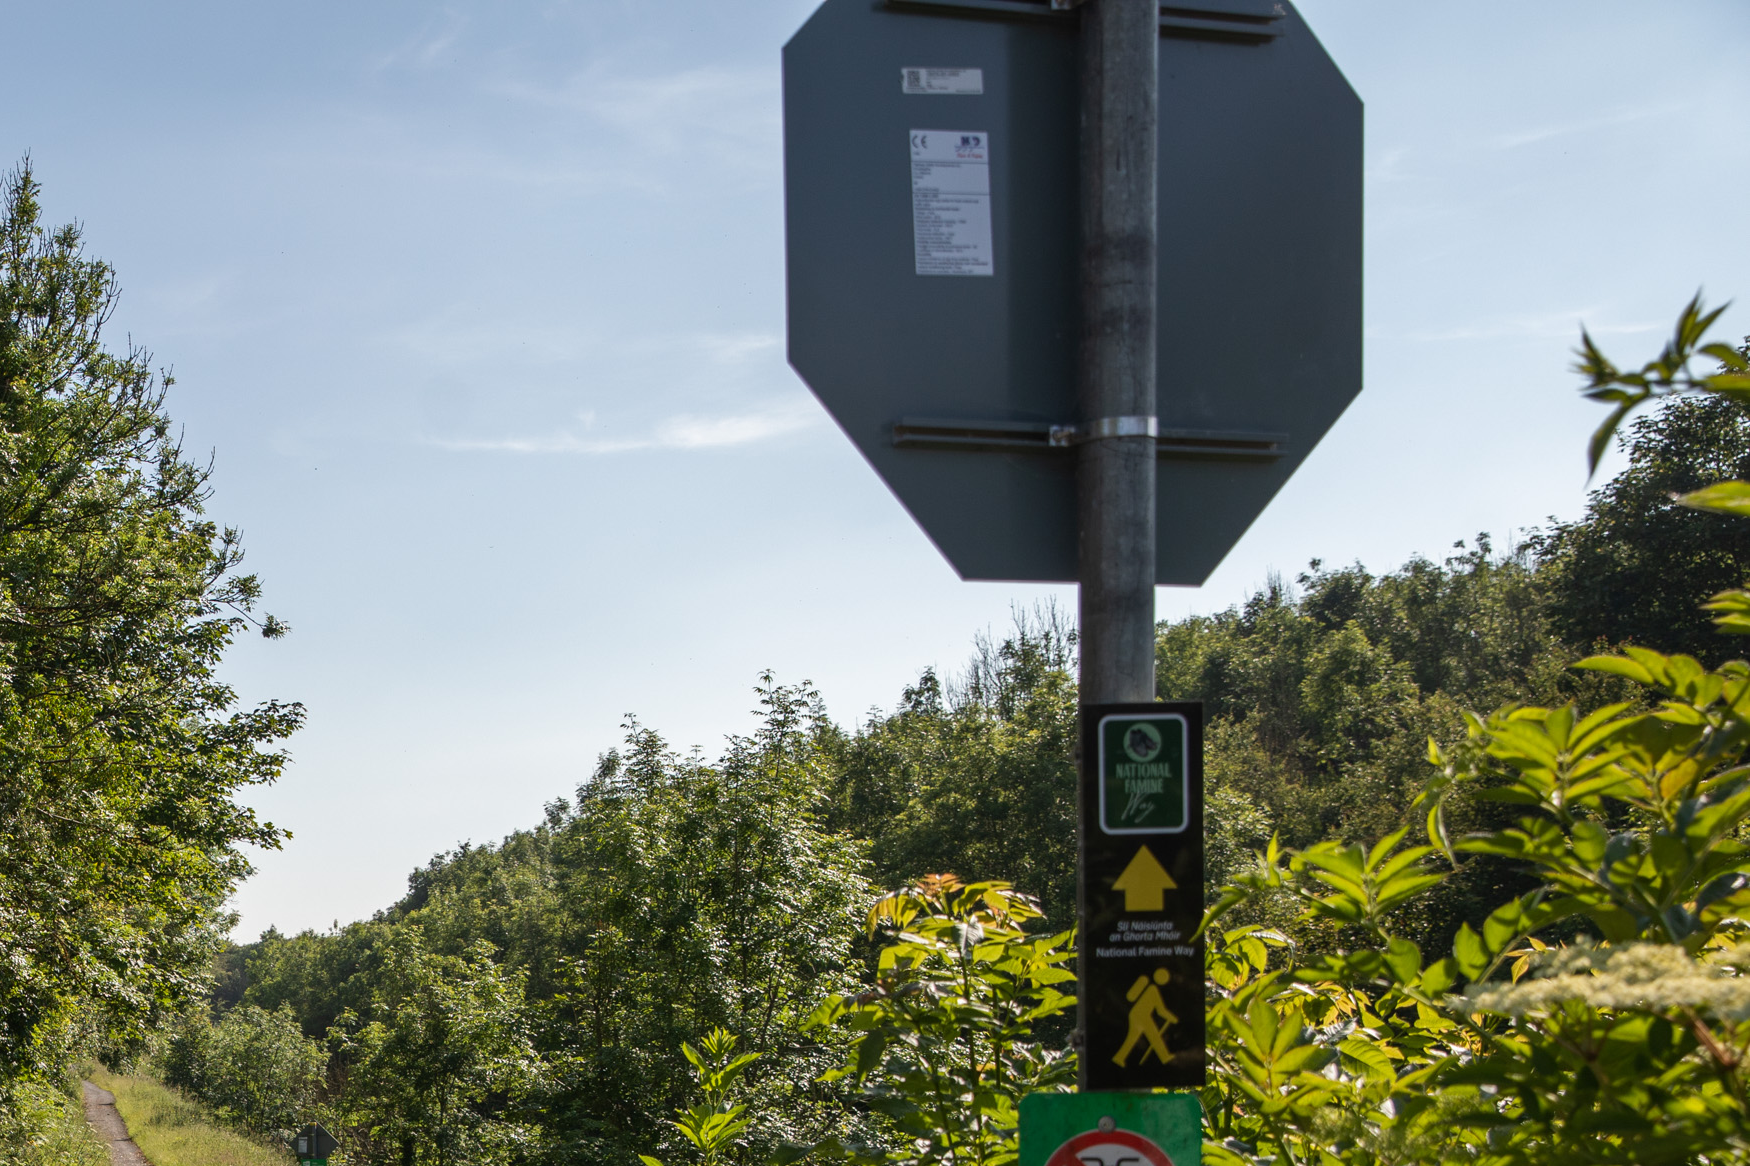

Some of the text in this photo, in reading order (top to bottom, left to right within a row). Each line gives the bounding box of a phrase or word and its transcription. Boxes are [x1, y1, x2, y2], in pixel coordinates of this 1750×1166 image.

[1116, 763, 1172, 778] NATIONAL
[1125, 778, 1164, 793] FAMINE
[1121, 790, 1155, 823] Way
[1109, 933, 1121, 942] an
[1123, 931, 1153, 942] Ghorta
[1096, 944, 1195, 958] National Famine Way
